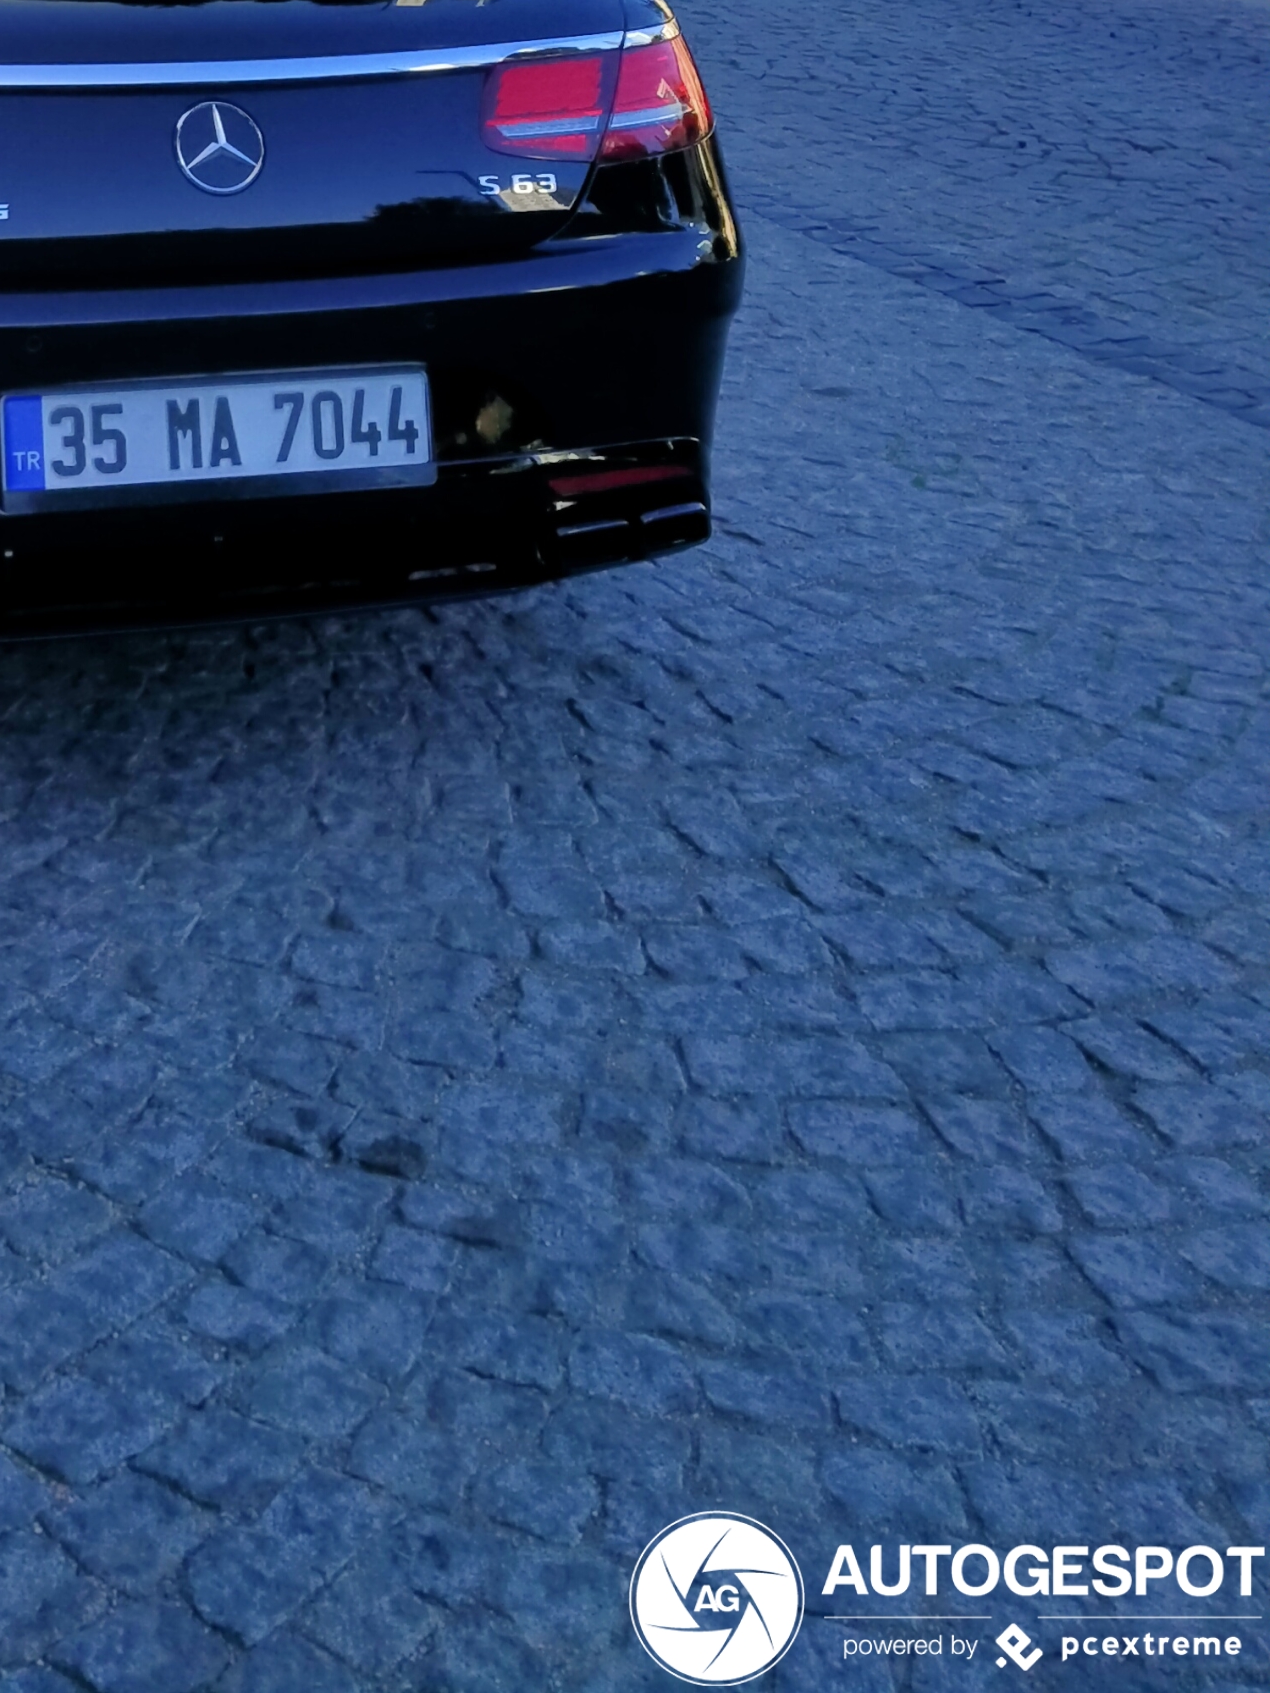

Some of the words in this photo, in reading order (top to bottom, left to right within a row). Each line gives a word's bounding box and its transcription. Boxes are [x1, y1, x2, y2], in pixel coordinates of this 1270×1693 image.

[478, 175, 501, 195] S
[511, 173, 557, 194] 63
[48, 403, 128, 477] 35
[166, 396, 243, 471] MA
[273, 385, 420, 462] 7044
[13, 452, 41, 472] TR
